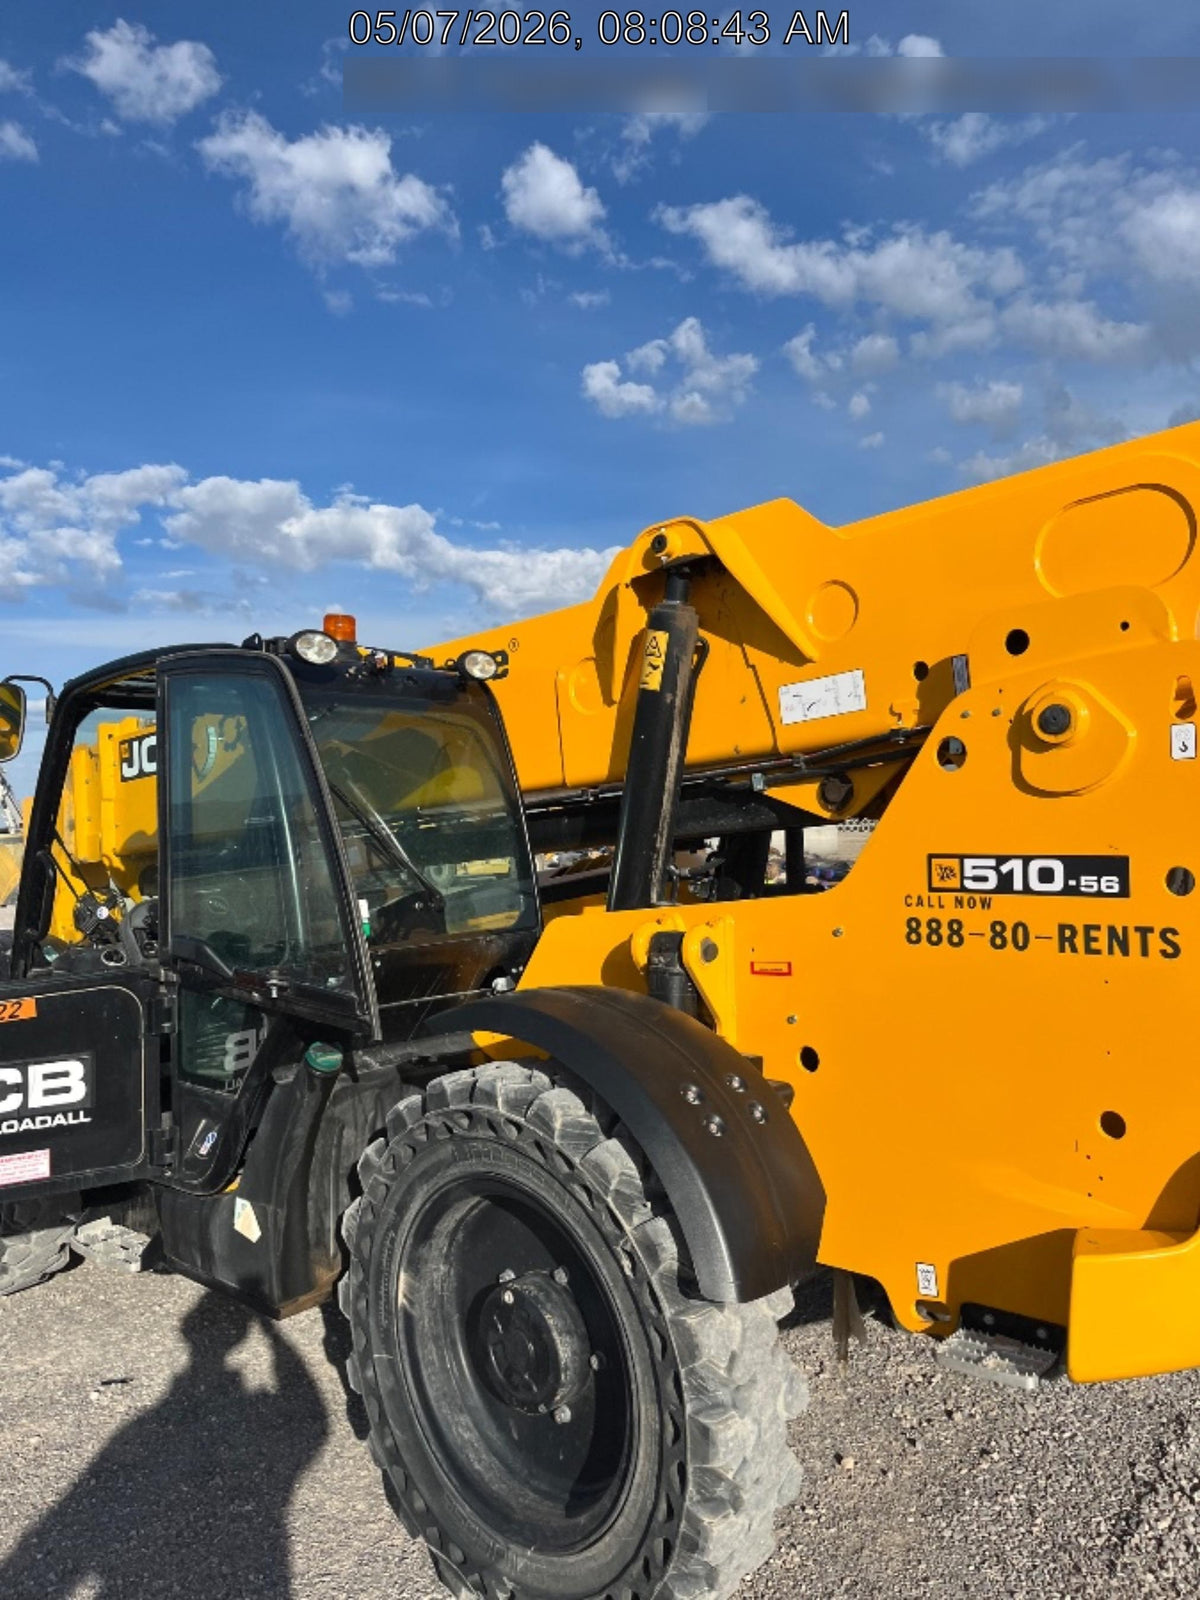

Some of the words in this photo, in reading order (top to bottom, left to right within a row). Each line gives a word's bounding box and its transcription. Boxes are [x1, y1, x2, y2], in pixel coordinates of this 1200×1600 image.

[904, 894, 946, 909] CALL
[953, 896, 993, 910] NOW
[904, 916, 1182, 960] 888-80-RENTS
[0, 1109, 92, 1134] OADALL
